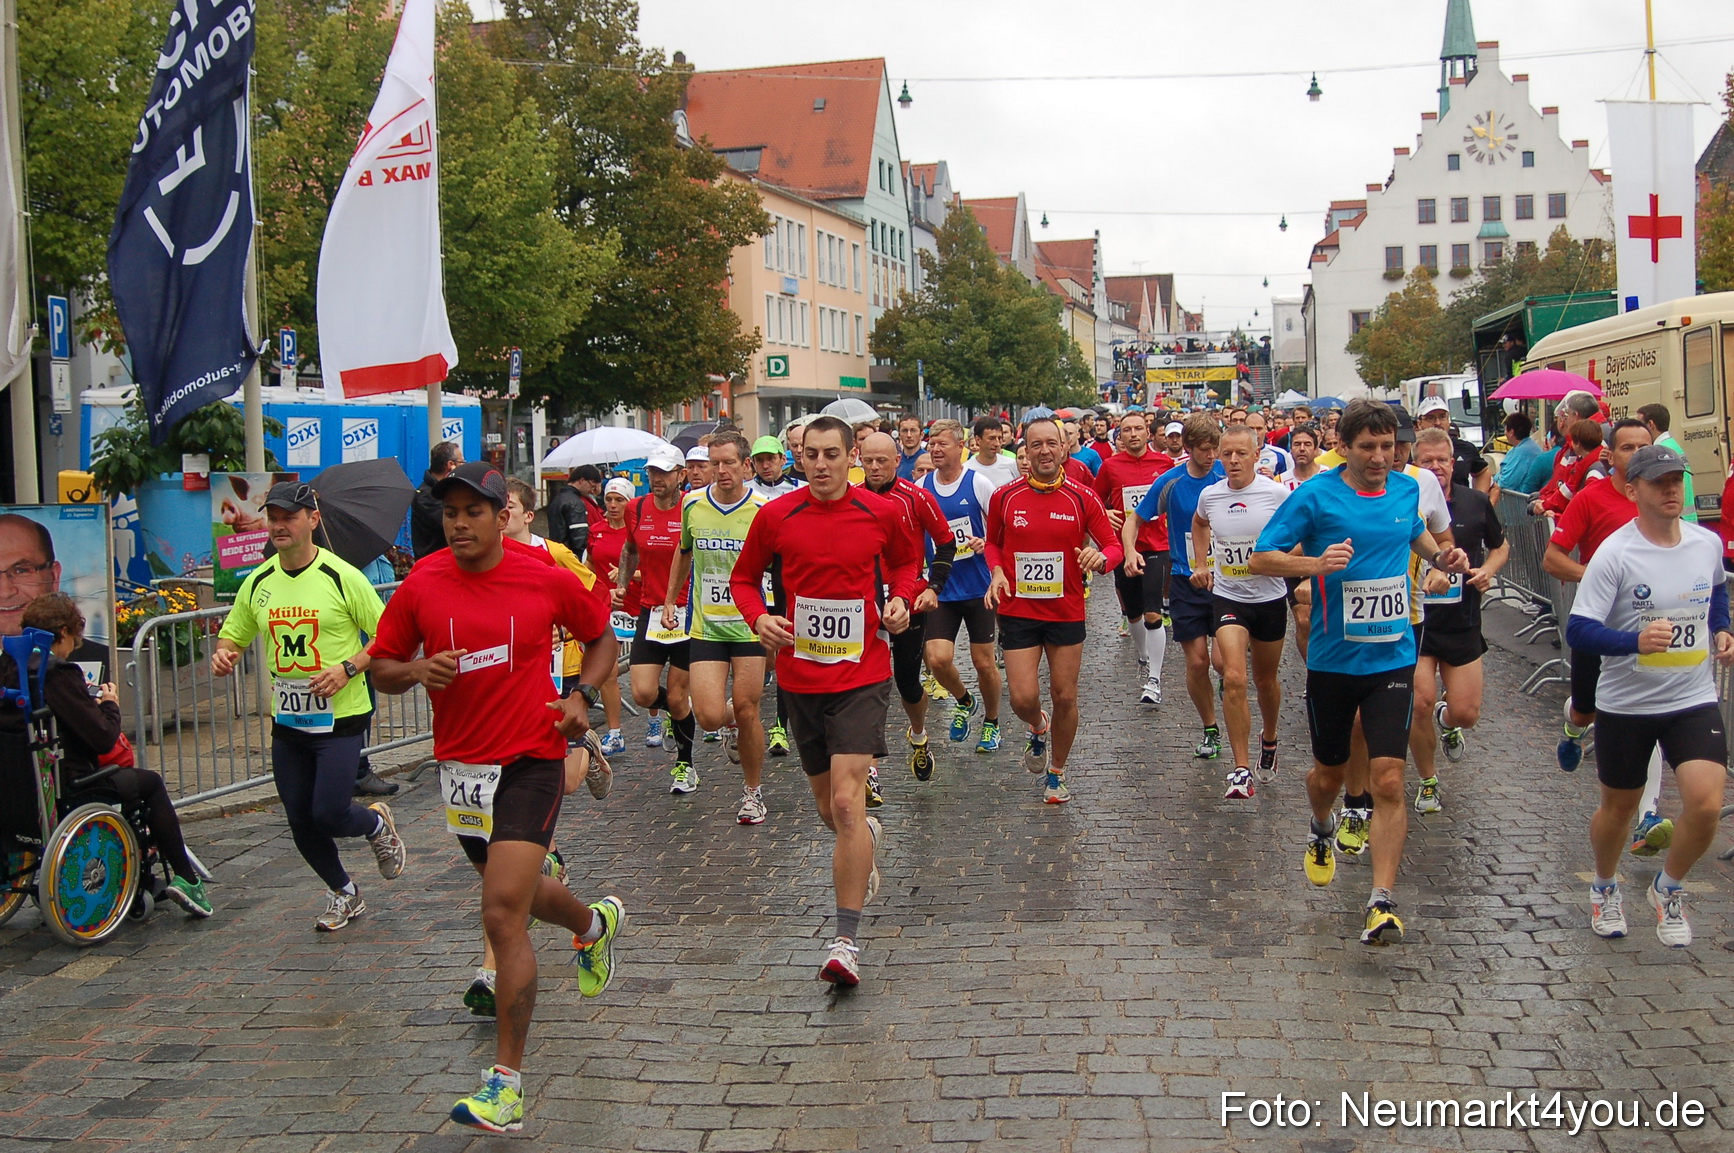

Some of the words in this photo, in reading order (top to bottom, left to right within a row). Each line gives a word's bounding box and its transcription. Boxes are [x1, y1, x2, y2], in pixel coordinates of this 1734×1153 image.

[53, 305, 64, 351] P
[283, 334, 293, 362] P
[769, 357, 786, 375] D
[1605, 348, 1657, 377] Bayerisches
[1175, 371, 1207, 379] START
[1606, 379, 1629, 398] Rotes
[1684, 427, 1713, 441] Bayerisches
[1050, 512, 1075, 521] Markus
[696, 528, 731, 537] TEAM
[1024, 564, 1054, 581] 228
[1027, 584, 1051, 592] Markus
[1344, 585, 1368, 593] PARTL
[1369, 583, 1399, 593] Neumarkt
[268, 606, 320, 620] Müller
[796, 603, 819, 612] PARTL
[820, 605, 853, 613] Neumarkt
[1351, 592, 1405, 620] 2708
[1667, 615, 1698, 623] Neumarkt
[807, 614, 851, 640] 390
[1367, 623, 1393, 635] Klaus
[1669, 623, 1696, 649] 28
[281, 634, 308, 658] M
[808, 643, 847, 655] Matthias
[472, 653, 495, 665] DEHN
[279, 691, 328, 713] 2070
[455, 768, 487, 779] Neumarkt
[450, 778, 484, 809] 214
